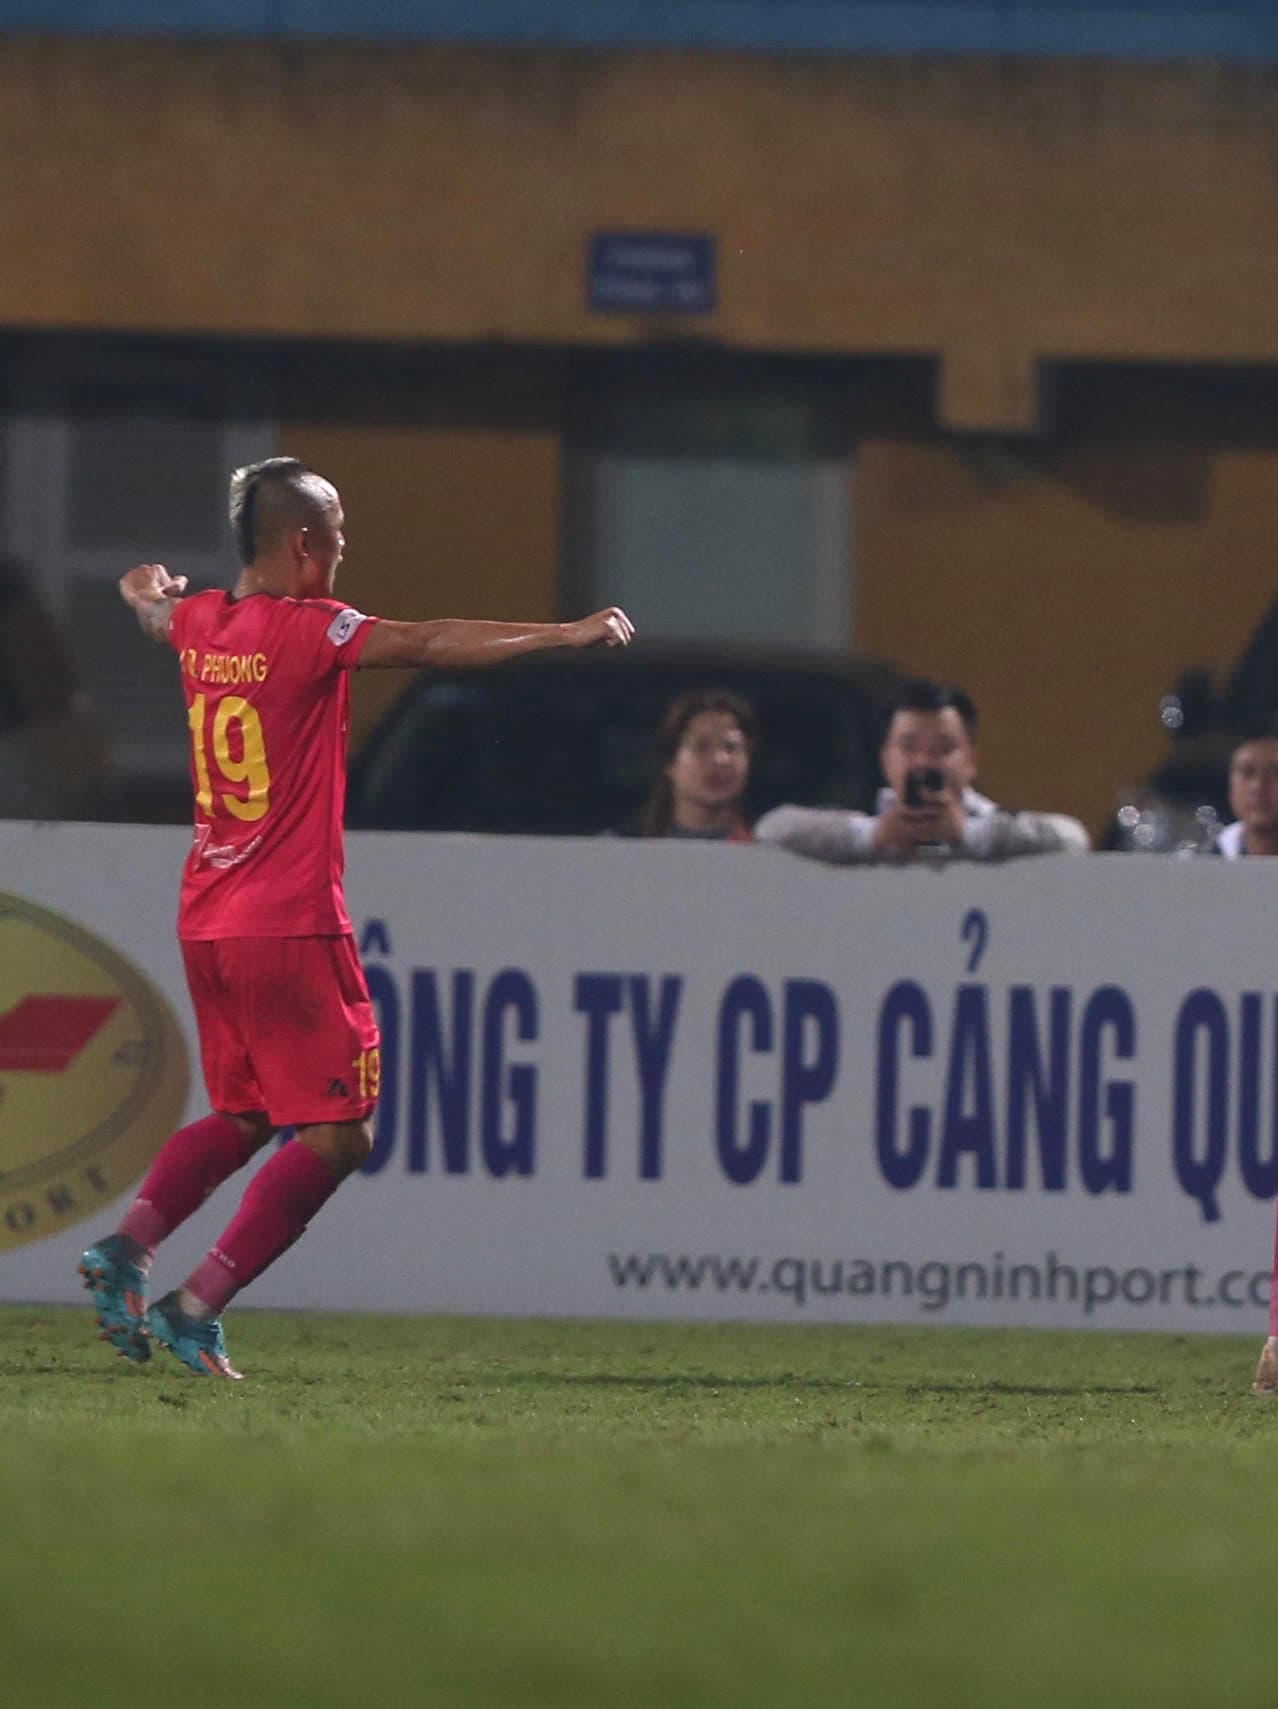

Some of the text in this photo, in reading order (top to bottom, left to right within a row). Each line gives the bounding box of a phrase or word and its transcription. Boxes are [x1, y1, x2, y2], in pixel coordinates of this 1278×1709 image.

[188, 692, 271, 822] 19
[352, 1049, 380, 1097] 19
[356, 916, 541, 1182] ÔNG
[574, 972, 686, 1181] TY
[714, 971, 840, 1187] CP
[876, 907, 1137, 1197] CẢNG
